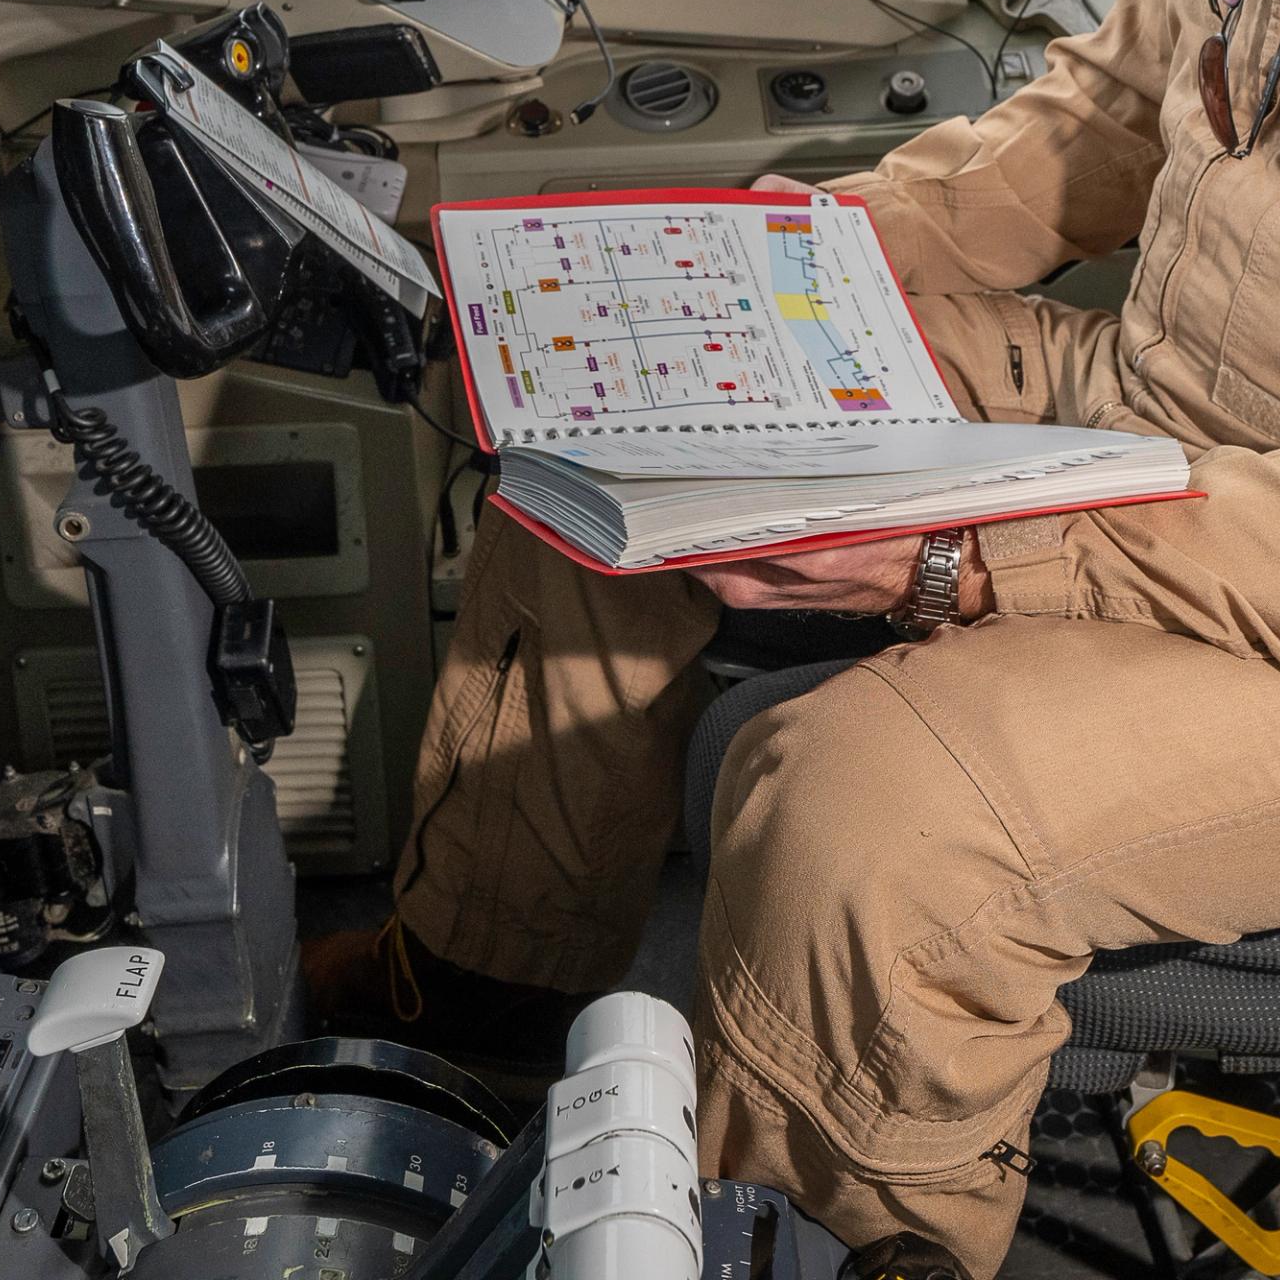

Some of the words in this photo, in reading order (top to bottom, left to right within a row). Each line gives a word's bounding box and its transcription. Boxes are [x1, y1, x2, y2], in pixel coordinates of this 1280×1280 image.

[115, 954, 150, 999] FLAP
[556, 1084, 620, 1117] TOGA
[262, 1140, 275, 1153] 18
[409, 1154, 422, 1172] 30
[455, 1173, 468, 1192] 33
[555, 1164, 621, 1198] TOGA
[736, 1184, 745, 1214] RIGHT
